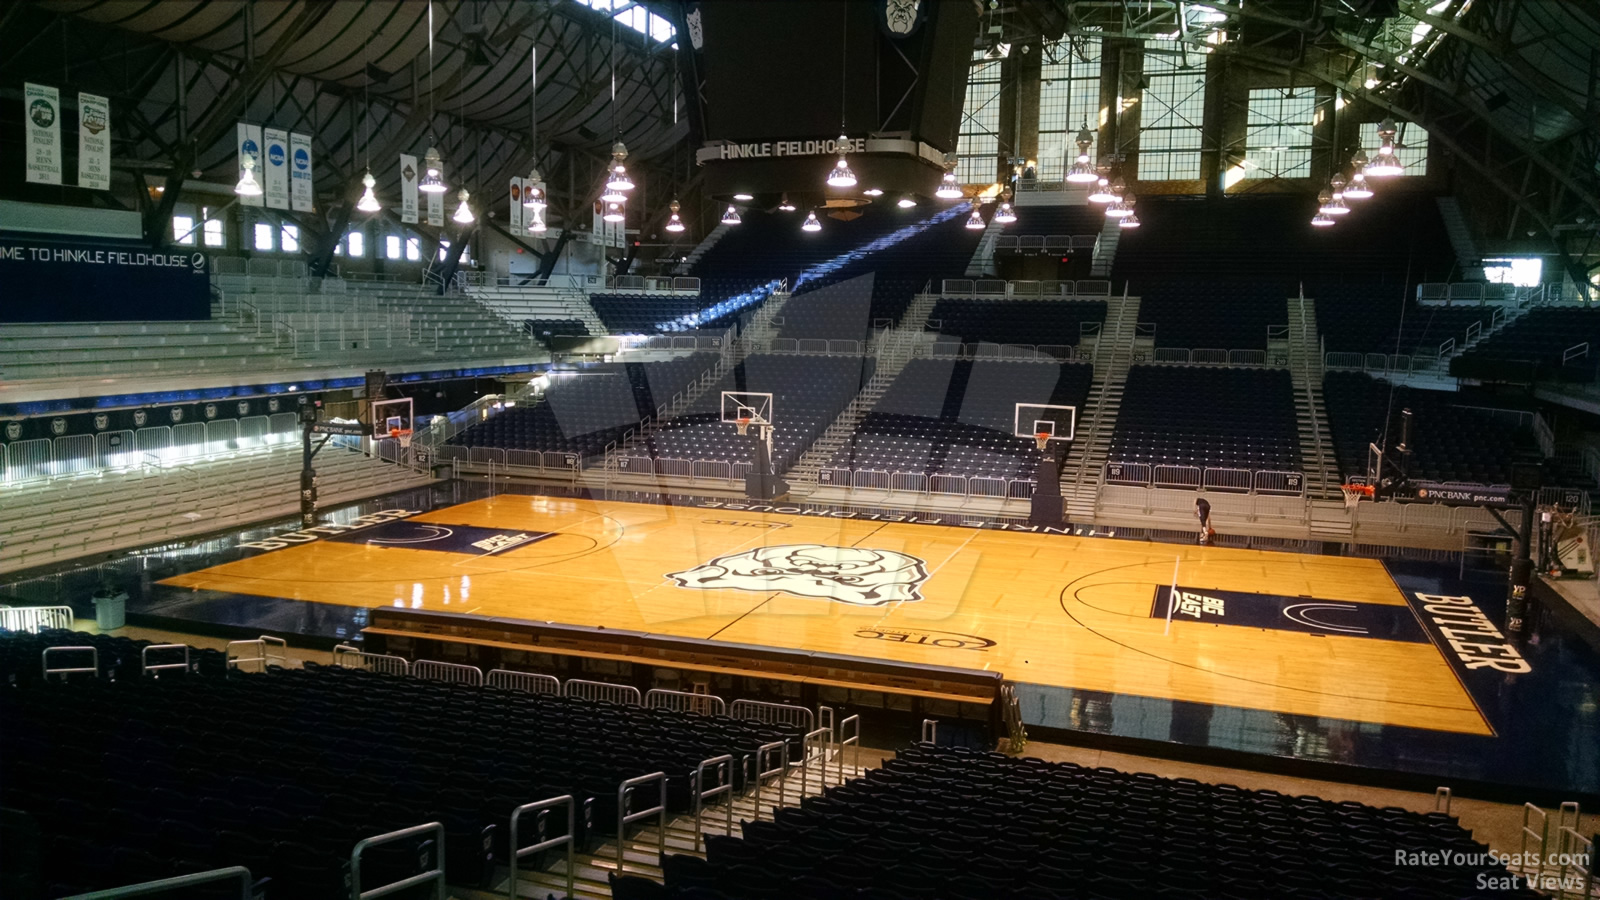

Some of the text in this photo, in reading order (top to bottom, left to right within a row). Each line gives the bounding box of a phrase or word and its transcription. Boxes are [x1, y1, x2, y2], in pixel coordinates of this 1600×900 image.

[270, 153, 284, 162] NCAA
[720, 138, 865, 160] HINKLE FIELDHOSE
[28, 163, 59, 173] BASKETBALL
[295, 158, 309, 166] NCAA
[80, 172, 107, 182] BASKETBALL
[0, 246, 188, 267] ME TO HINKLE FIELDHOUSE
[1473, 494, 1506, 503] pnc.com
[1565, 494, 1579, 503] 120
[697, 501, 1115, 538] HINKLE FIELDHOUSE
[235, 509, 423, 551] BUTLER
[471, 534, 510, 548] BIG
[480, 533, 529, 551] EAST
[1180, 592, 1202, 618] EAST
[1202, 596, 1225, 616] BIG
[1414, 592, 1532, 674] BUTLER
